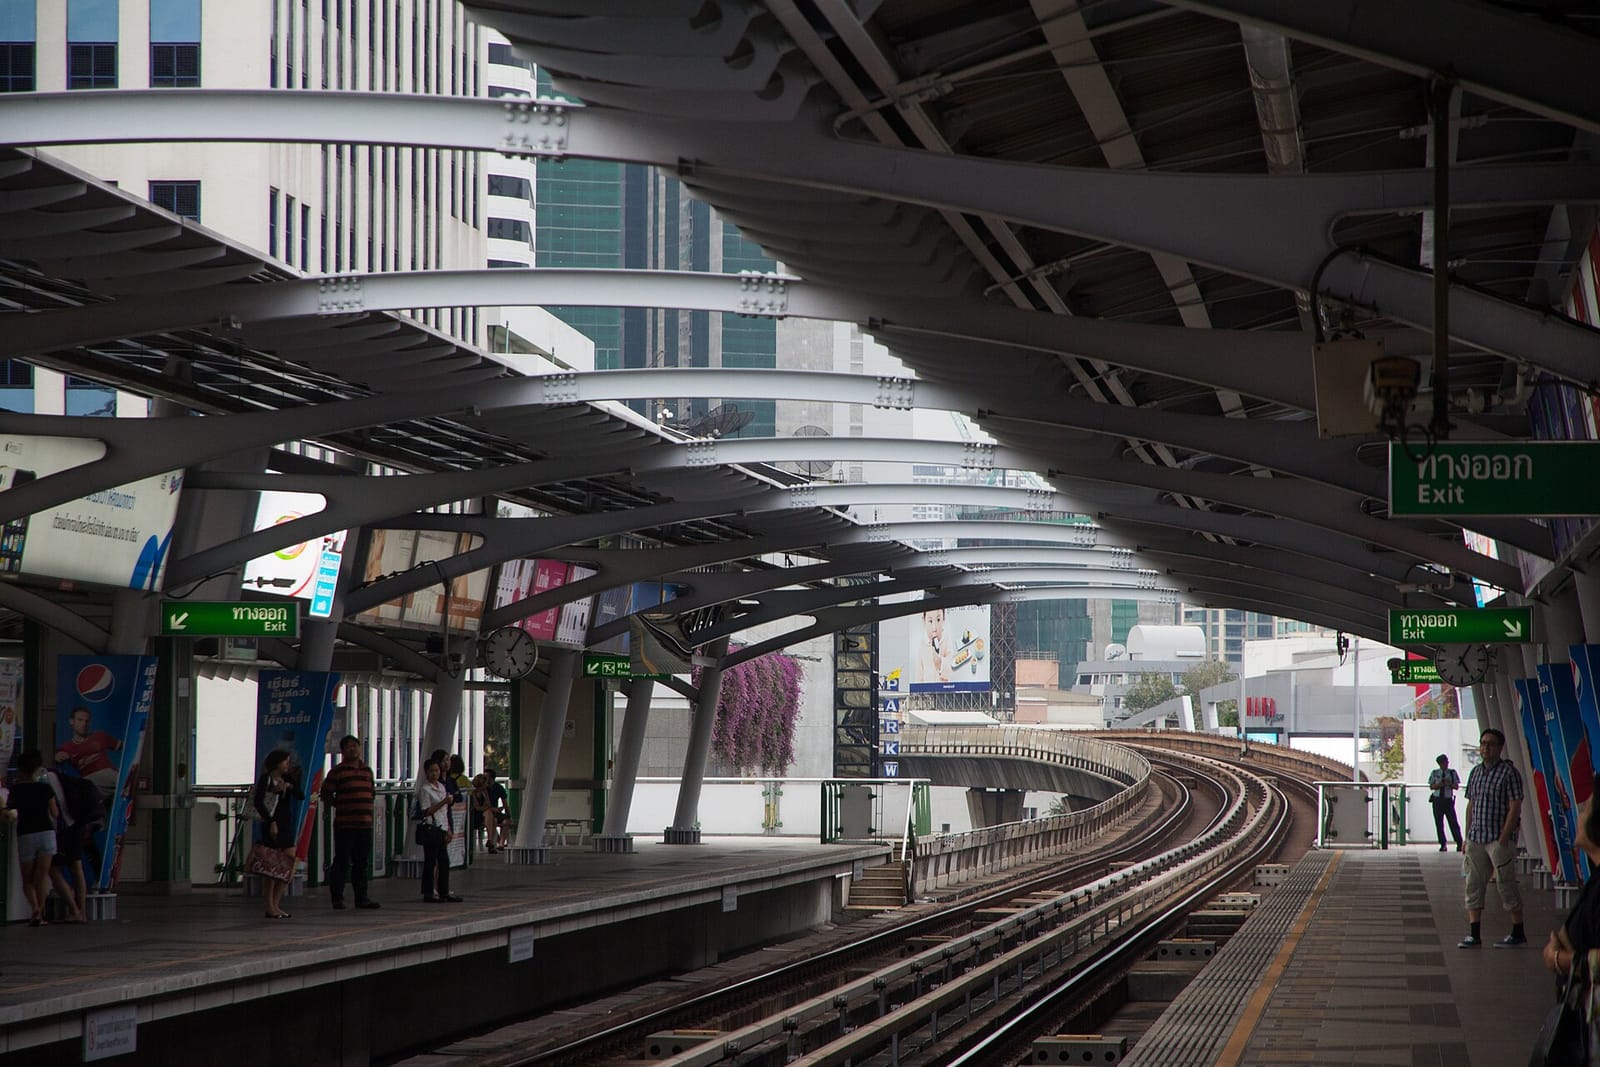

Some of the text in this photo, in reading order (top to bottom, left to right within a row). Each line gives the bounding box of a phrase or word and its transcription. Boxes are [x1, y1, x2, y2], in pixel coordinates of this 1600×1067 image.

[1416, 453, 1533, 480] ทางออก
[1417, 483, 1465, 504] Exit
[232, 606, 287, 620] ทางออก
[264, 621, 287, 632] Exit
[1400, 613, 1457, 628] ทางออก
[1402, 628, 1425, 640] Exit
